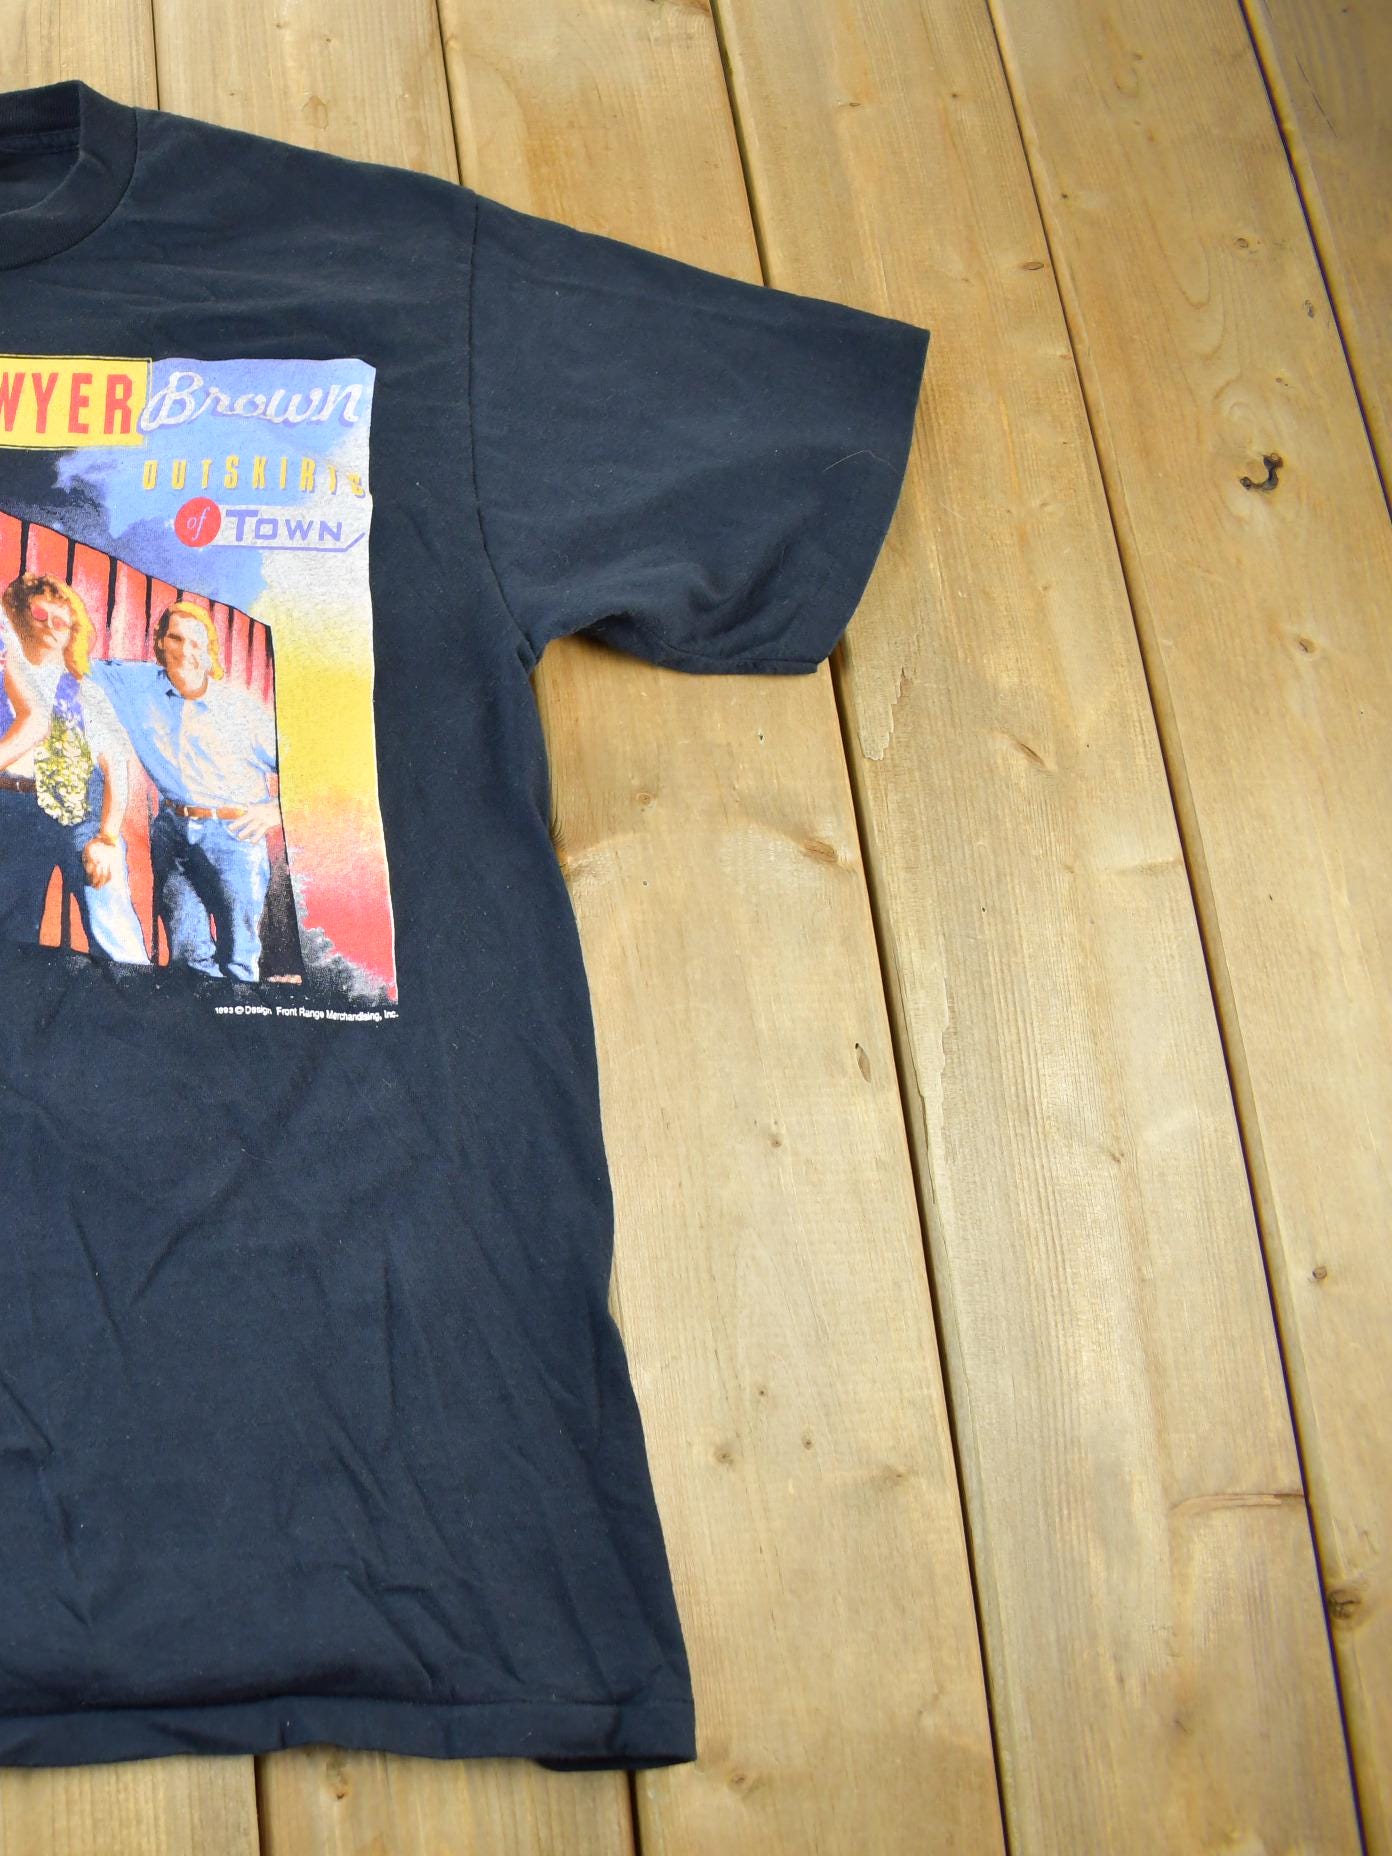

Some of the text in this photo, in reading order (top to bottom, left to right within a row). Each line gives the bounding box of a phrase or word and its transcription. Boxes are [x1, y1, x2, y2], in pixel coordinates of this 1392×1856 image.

[139, 370, 364, 432] Brown
[186, 506, 211, 541] of
[275, 1006, 298, 1017] Front
[298, 1006, 325, 1020] Range
[383, 1010, 400, 1020] Inc.
